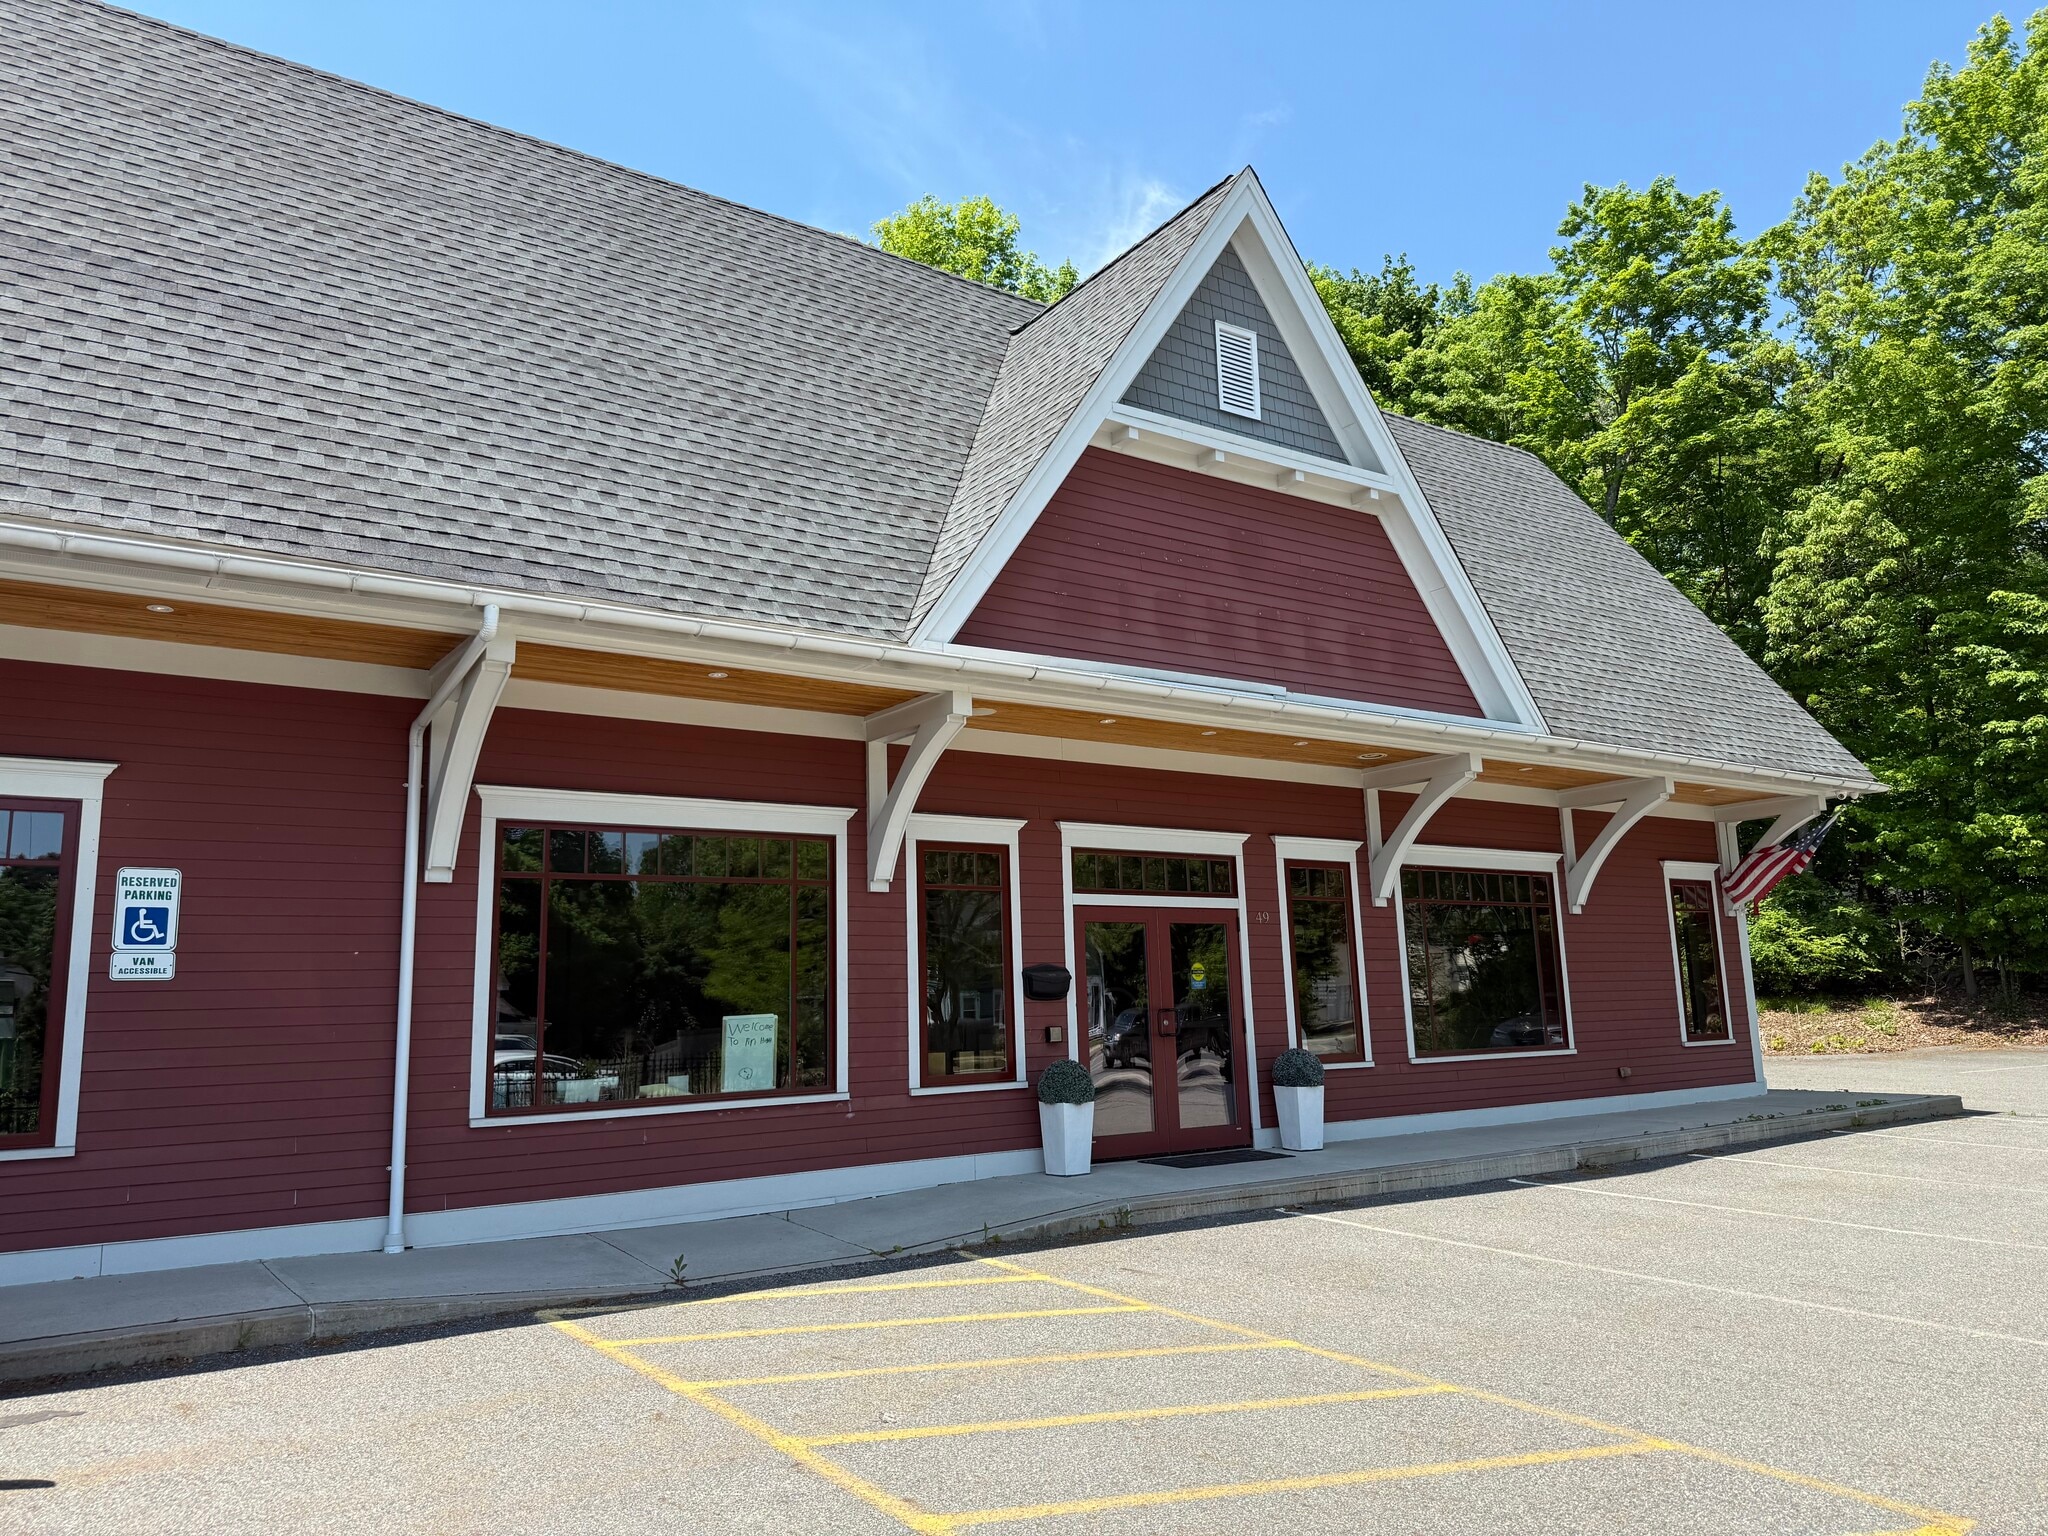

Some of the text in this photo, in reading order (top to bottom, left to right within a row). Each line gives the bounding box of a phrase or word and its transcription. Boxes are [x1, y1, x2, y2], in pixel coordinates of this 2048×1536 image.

[121, 877, 177, 887] RESERVED
[124, 890, 172, 900] PARKING
[1255, 911, 1269, 924] 49
[132, 957, 155, 966] VAN
[118, 967, 168, 975] ACCESSIBLE
[728, 1036, 739, 1047] To
